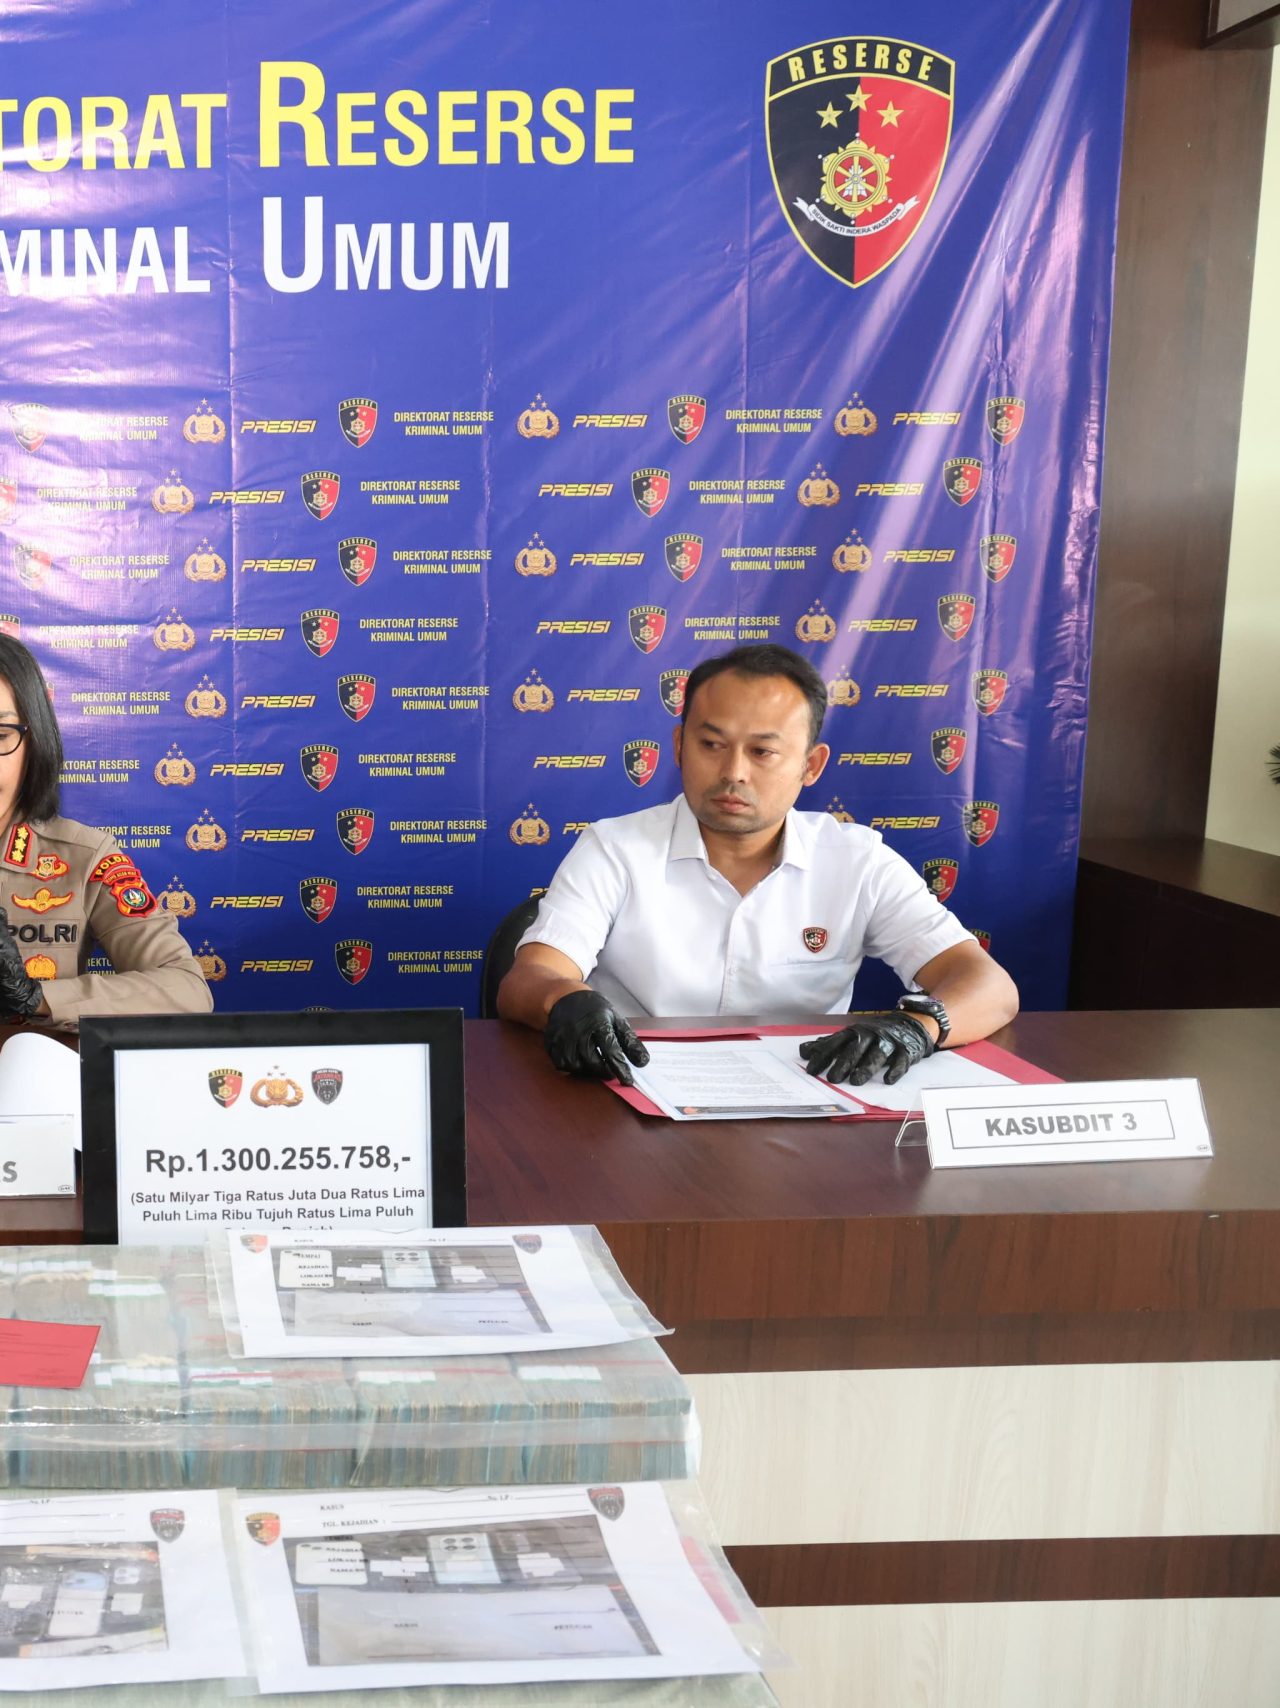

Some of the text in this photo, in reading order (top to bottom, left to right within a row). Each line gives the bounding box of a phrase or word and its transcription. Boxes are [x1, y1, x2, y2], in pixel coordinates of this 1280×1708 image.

[787, 42, 935, 83] RESERSE
[259, 61, 635, 168] RESERSE
[826, 220, 846, 233] SAKTI
[846, 227, 872, 235] INDERA
[872, 208, 902, 232] WASPADA
[262, 196, 511, 293] UMUM
[393, 410, 494, 423] DIREKTORAT RESERSE
[573, 413, 648, 428] PRESISI
[725, 408, 822, 420] DIREKTORAT RESERSE
[892, 411, 961, 427] PRESISI
[240, 419, 318, 434] PRESISI
[404, 424, 484, 436] KRIMINAL UMUM
[735, 422, 813, 433] KRIMINAL UMUM
[360, 480, 460, 492] DIREKTORAT RESERSE
[538, 482, 615, 497] PRESISI
[688, 479, 785, 491] DIREKTORAT RESERSE
[855, 482, 924, 497] PRESISI
[209, 489, 286, 505] PRESISI
[371, 493, 450, 505] KRIMINAL UMUM
[699, 493, 775, 504] KRIMINAL UMUM
[392, 549, 491, 561] DIREKTORAT RESERSE
[569, 552, 645, 567] PRESISI
[720, 546, 817, 558] DIREKTORAT RESERSE
[883, 548, 956, 563] PRESISI
[70, 555, 169, 566] DIREKTORAT RESERSE
[240, 558, 318, 573] PRESISI
[730, 559, 806, 571] KRIMINAL UMUM
[128, 568, 159, 579] UMUM
[403, 563, 481, 574] KRIMINAL UMUM
[536, 620, 612, 635] PRESISI
[391, 685, 489, 697] DIREKTORAT RESERSE
[874, 683, 950, 698] PRESISI
[240, 694, 317, 709] PRESISI
[401, 699, 480, 710] KRIMINAL UMUM
[358, 752, 456, 764] DIREKTORAT RESERSE
[837, 751, 913, 766] PRESISI
[210, 762, 286, 777] PRESISI
[369, 765, 446, 777] KRIMINAL UMUM
[241, 828, 316, 843] PRESISI
[95, 855, 130, 876] POLDA
[357, 885, 454, 896] DIREKTORAT RESERSE
[367, 898, 444, 909] KRIMINAL UMUM
[240, 959, 315, 973] PRESISI
[984, 1112, 1137, 1136] KASUBDIT 3
[145, 1145, 411, 1178] Rp.1.300.255.758,-
[130, 1186, 426, 1206] (Satu Milyar Tiga Ratus Juta Dua Ratus Lima
[142, 1206, 414, 1223] Puluh Lima Ribu Tujuh Ratus Lima Puluh
